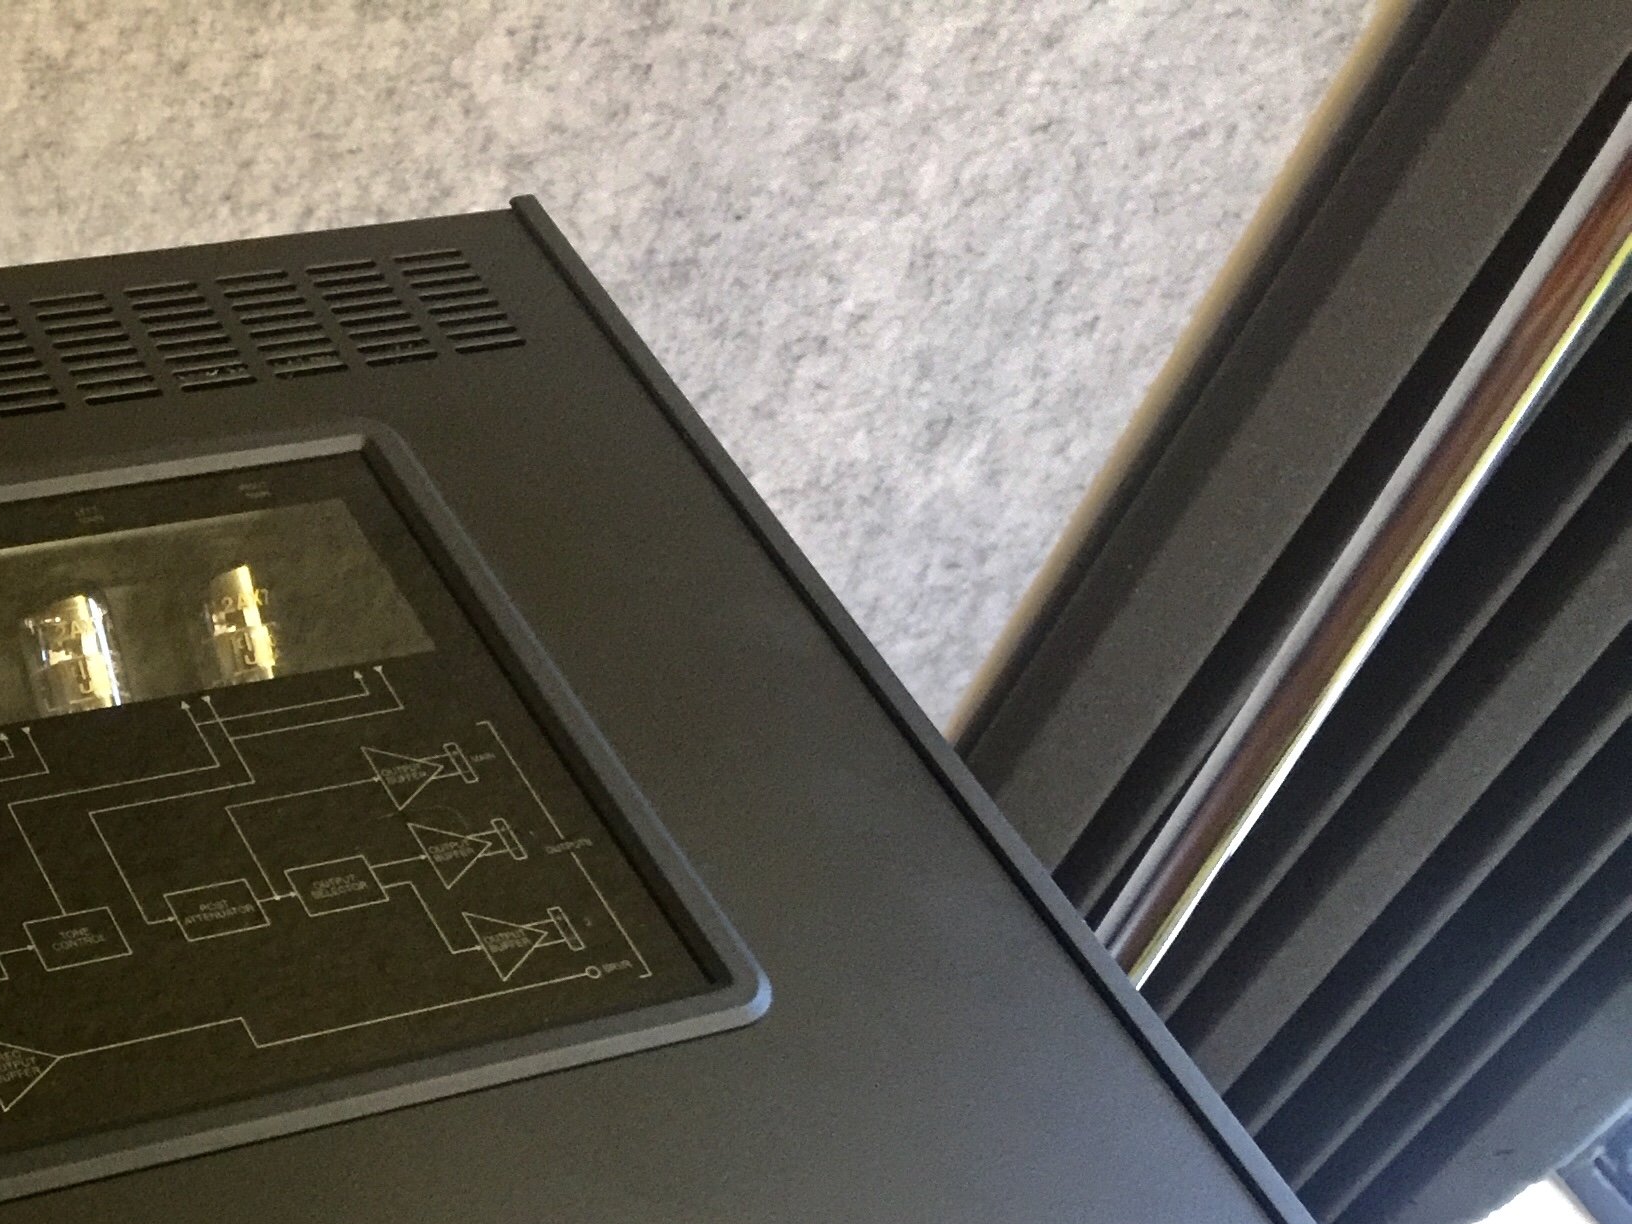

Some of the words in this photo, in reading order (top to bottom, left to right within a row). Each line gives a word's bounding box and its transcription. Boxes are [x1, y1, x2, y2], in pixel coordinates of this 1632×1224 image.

[184, 903, 256, 927] ATTENUATOR
[52, 933, 106, 953] CONTROL
[58, 927, 90, 942] TONE
